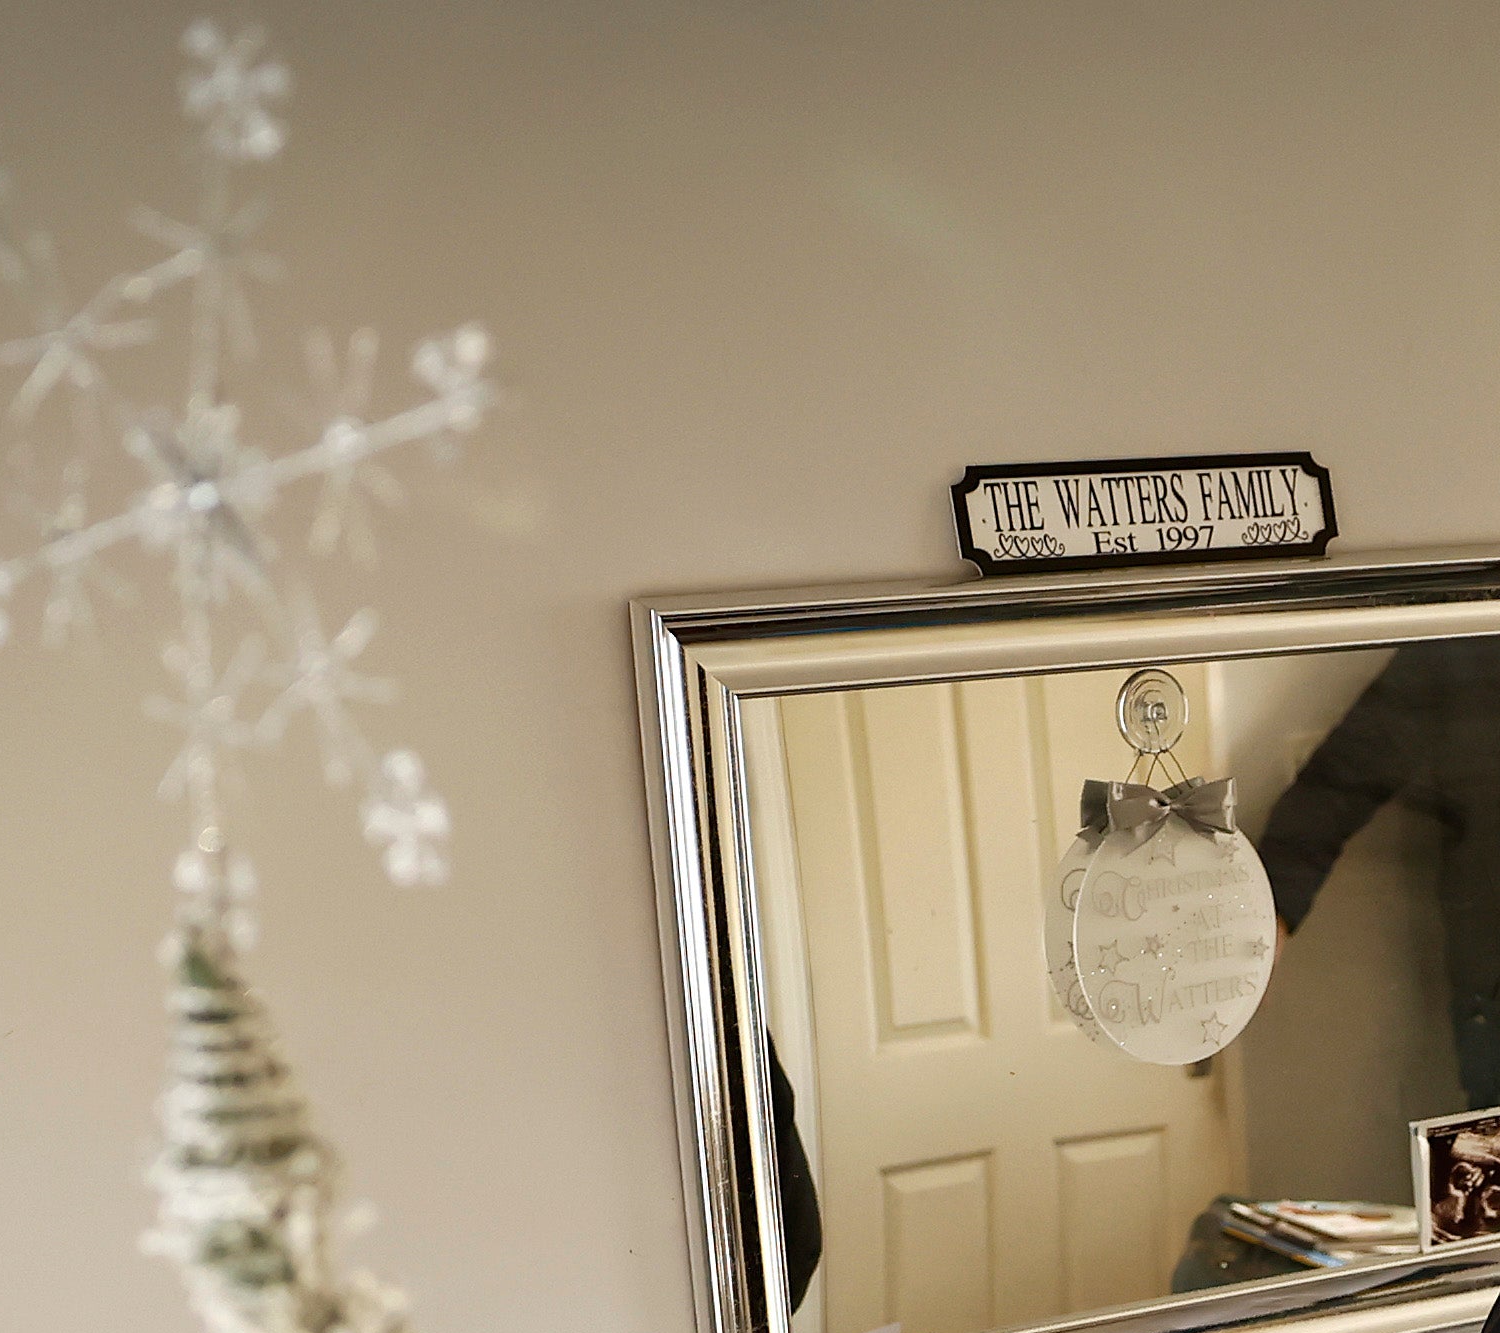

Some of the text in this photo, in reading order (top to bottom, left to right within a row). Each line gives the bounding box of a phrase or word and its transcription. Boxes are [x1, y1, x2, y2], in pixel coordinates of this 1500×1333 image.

[984, 467, 1299, 532] THE WATTERS FAMILY
[1093, 525, 1214, 554] Est 1997
[1187, 933, 1234, 963] THE
